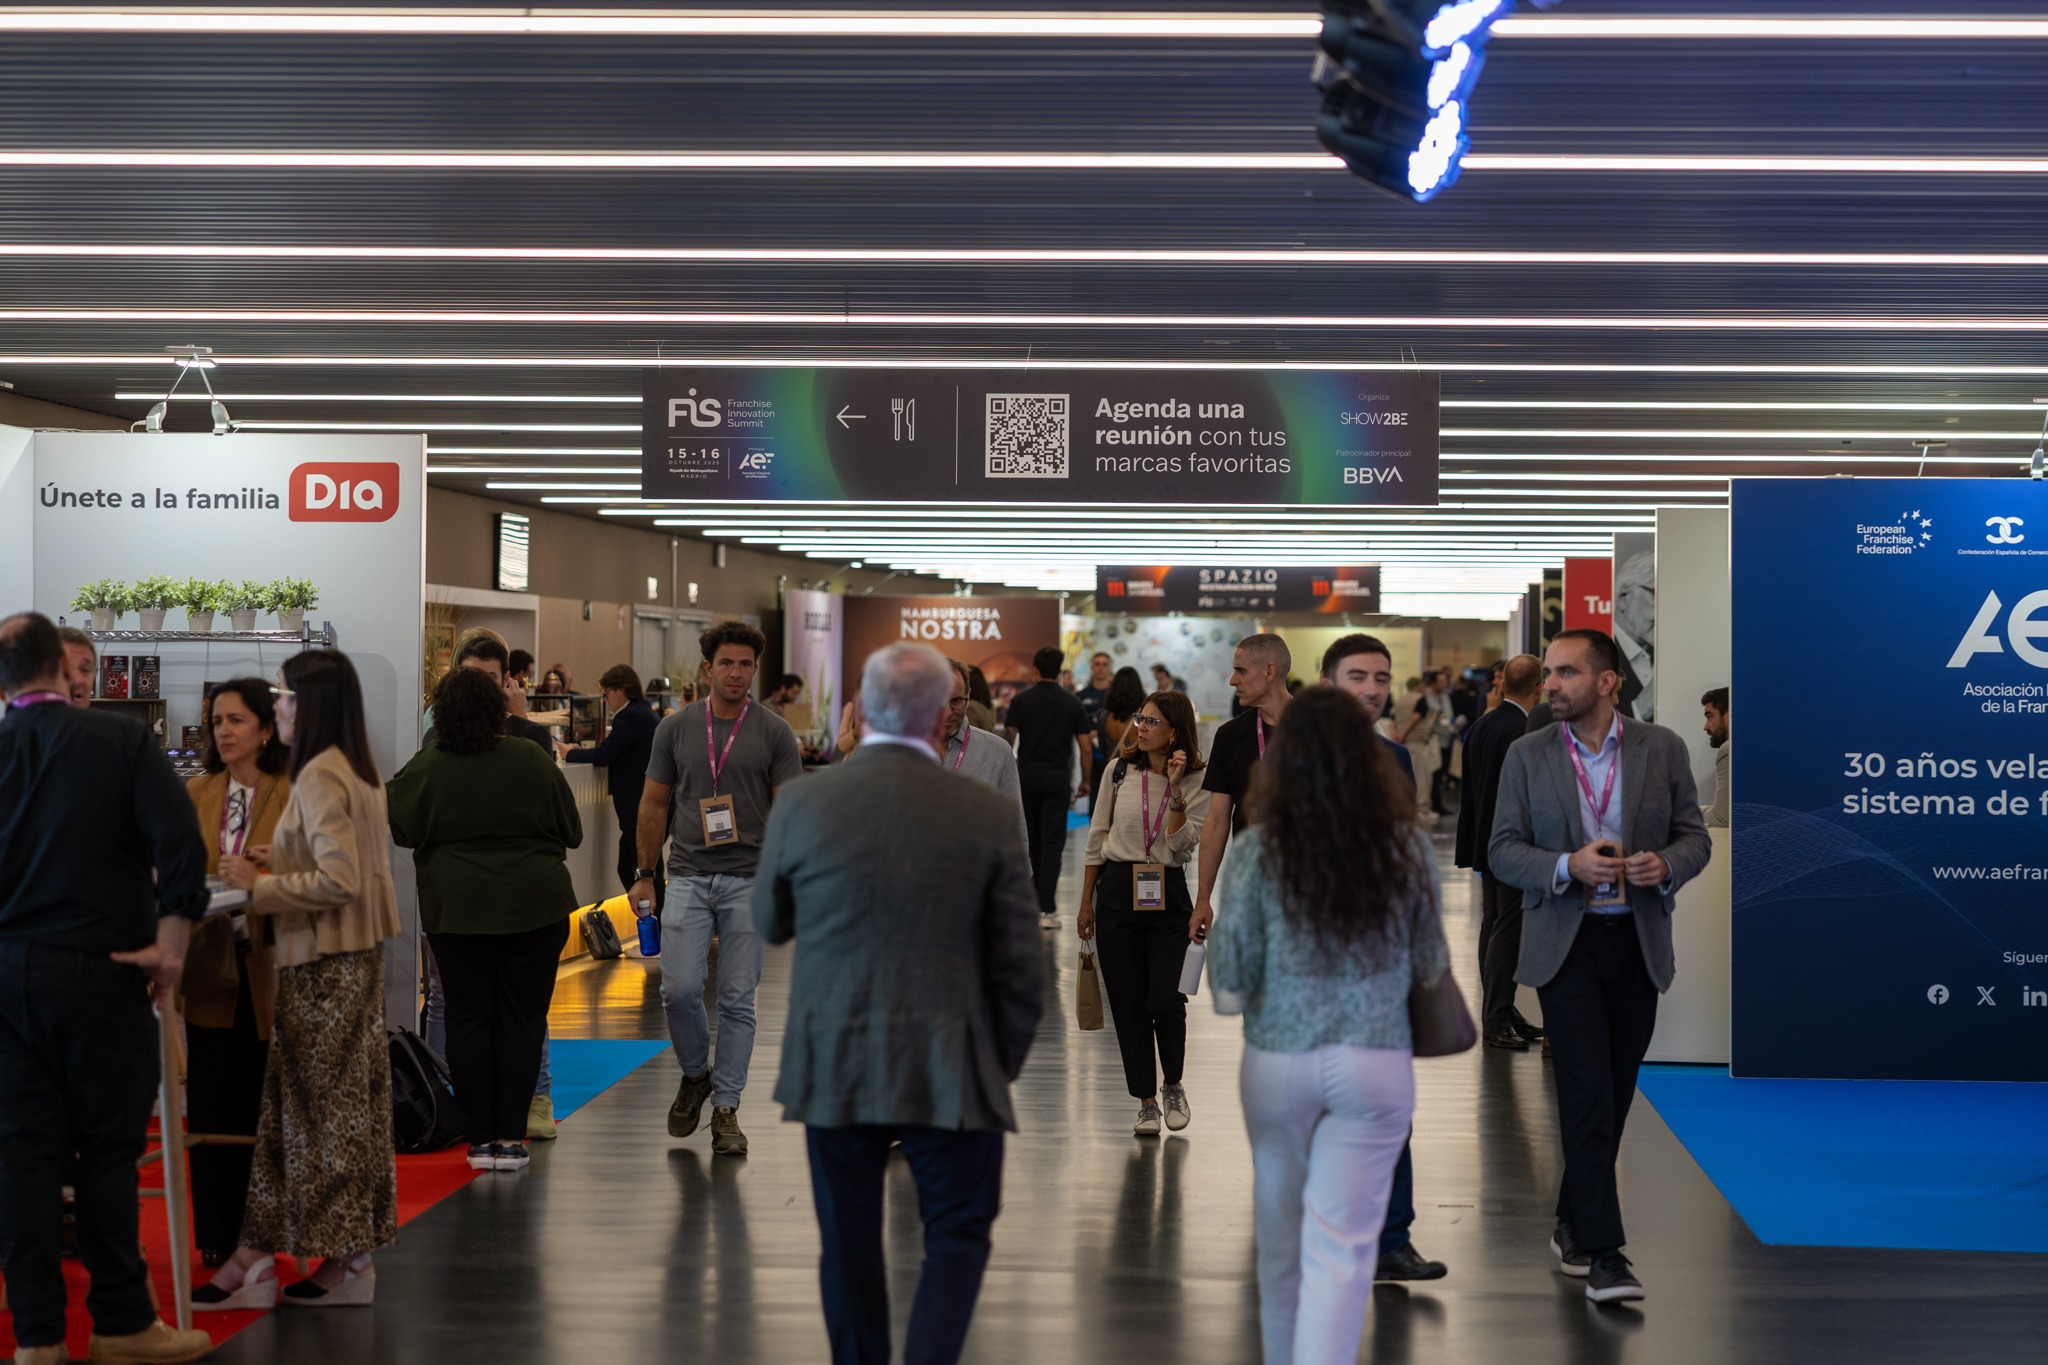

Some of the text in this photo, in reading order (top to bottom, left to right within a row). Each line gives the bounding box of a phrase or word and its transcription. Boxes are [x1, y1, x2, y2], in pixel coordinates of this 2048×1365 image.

[727, 399, 772, 408] Franchise
[1358, 393, 1391, 402] Organiza:
[727, 409, 775, 418] Innovation
[1095, 398, 1245, 422] Agenda una
[727, 419, 764, 428] Summit
[1341, 412, 1408, 425] SHOW2BE
[1095, 424, 1286, 446] reunión con tus
[1335, 449, 1412, 458] Patrocinador principal:
[1095, 453, 1291, 473] marcas favoritas
[1344, 466, 1403, 484] BBVA
[40, 482, 280, 510] Únete a la familia
[1856, 524, 1906, 536] European
[1863, 534, 1914, 544] Franchise
[1856, 544, 1912, 554] Federation
[1199, 569, 1278, 583] SPAZIO
[1584, 595, 1612, 614] Tu
[900, 607, 1001, 621] HAMBURGUESA
[900, 620, 1002, 640] NOSTRA
[1963, 682, 2043, 697] Asociación
[1981, 700, 2000, 713] de
[2003, 700, 2015, 713] la
[1844, 752, 1885, 778] 30
[1896, 752, 1977, 778] años
[1843, 787, 1975, 815] sistema
[1986, 790, 2030, 816] de
